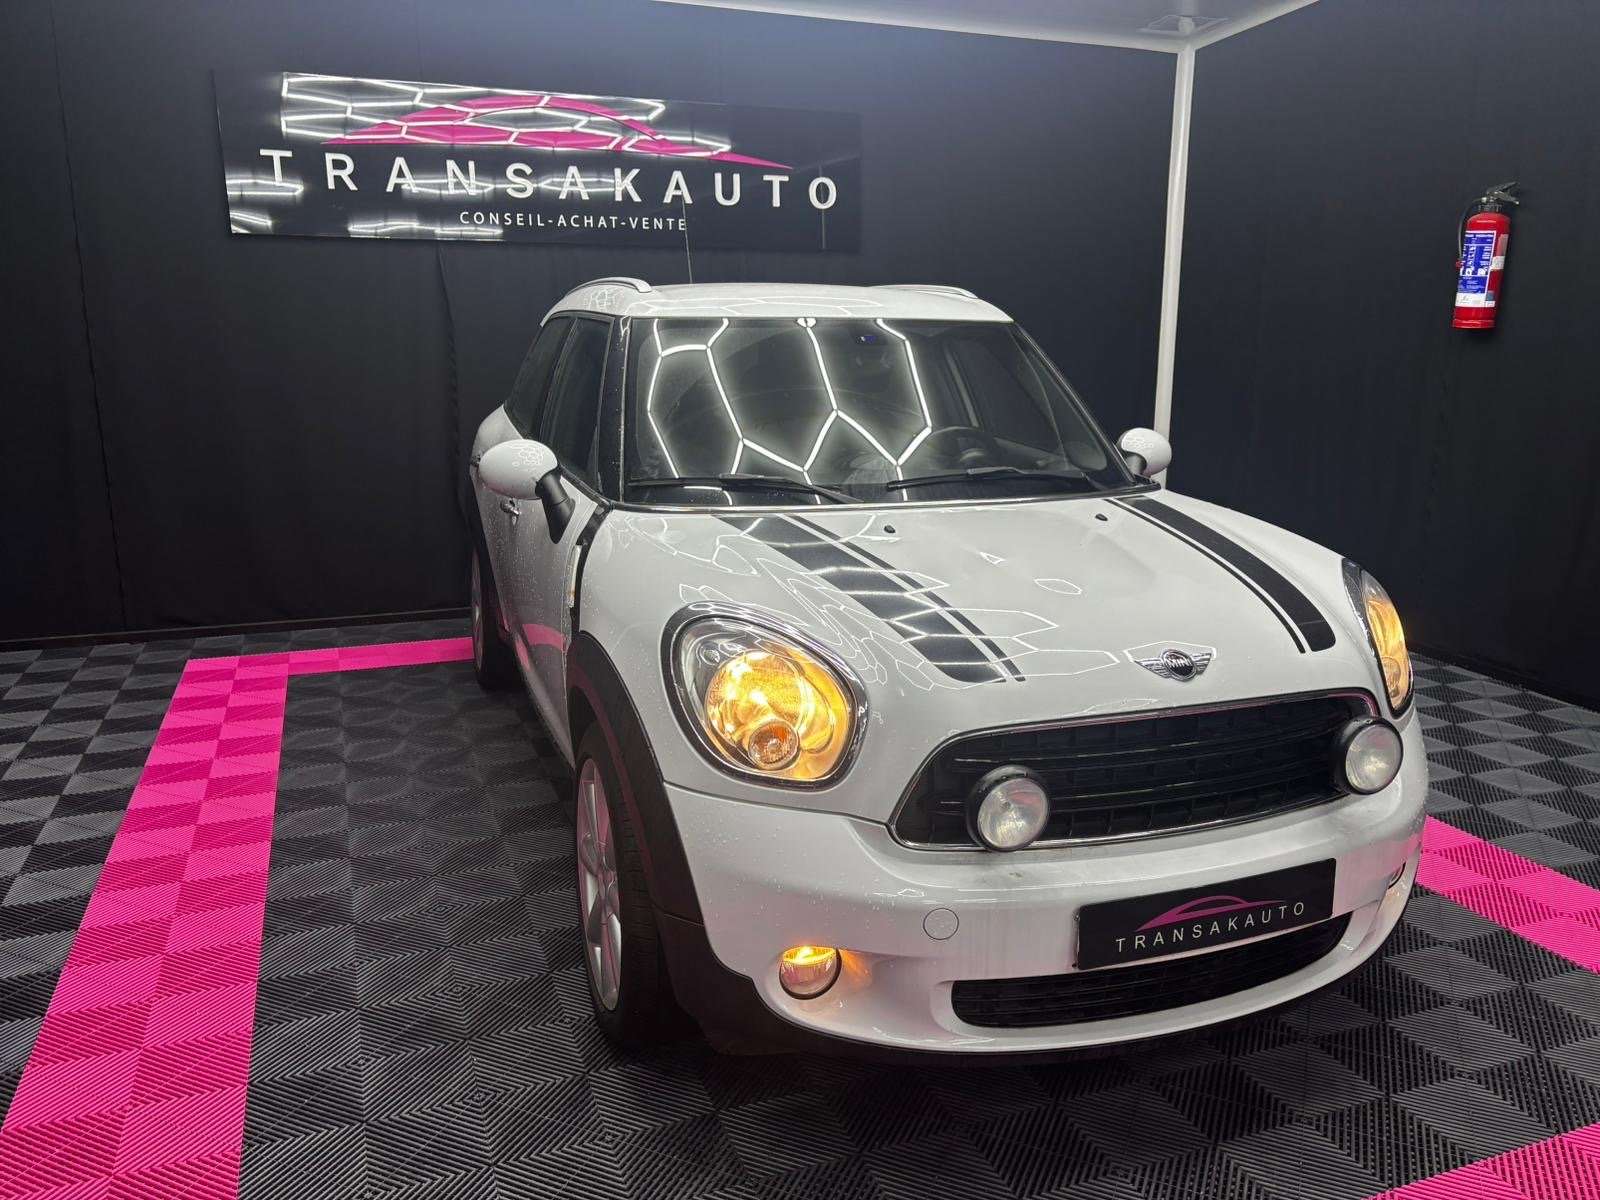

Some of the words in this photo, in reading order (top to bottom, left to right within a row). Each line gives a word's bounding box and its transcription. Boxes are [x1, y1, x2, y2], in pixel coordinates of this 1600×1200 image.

[259, 148, 837, 209] TRANSAKAUTO
[459, 211, 688, 231] CONSEIL-ACHAT-VENTE
[1115, 902, 1305, 952] TRANSAKAUTO
